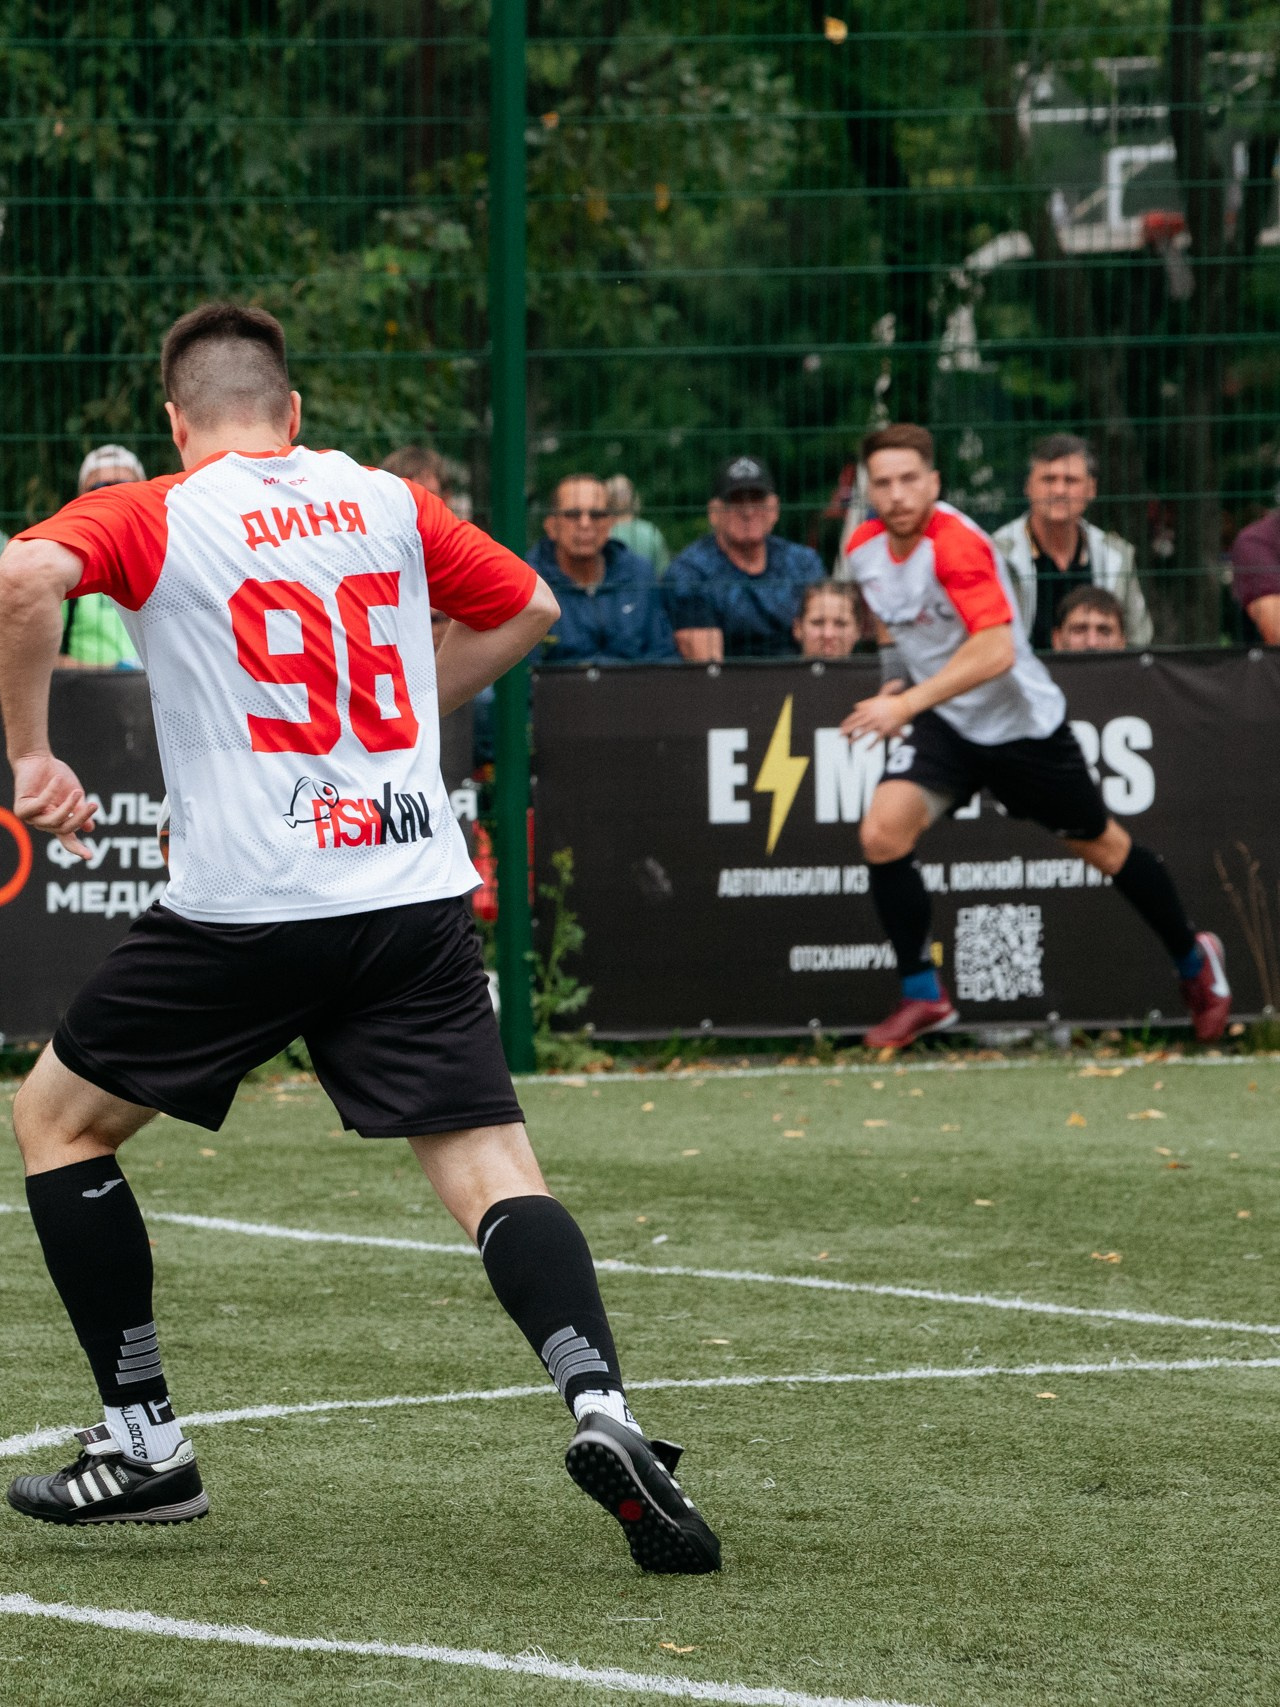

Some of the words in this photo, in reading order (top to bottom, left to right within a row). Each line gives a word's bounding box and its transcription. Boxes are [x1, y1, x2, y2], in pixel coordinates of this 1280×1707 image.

[239, 500, 367, 552] ДИНЯ
[227, 571, 419, 756] 96
[46, 837, 166, 869] ФУТБ
[842, 864, 870, 895] ИЗ
[46, 880, 167, 919] МЕДИ
